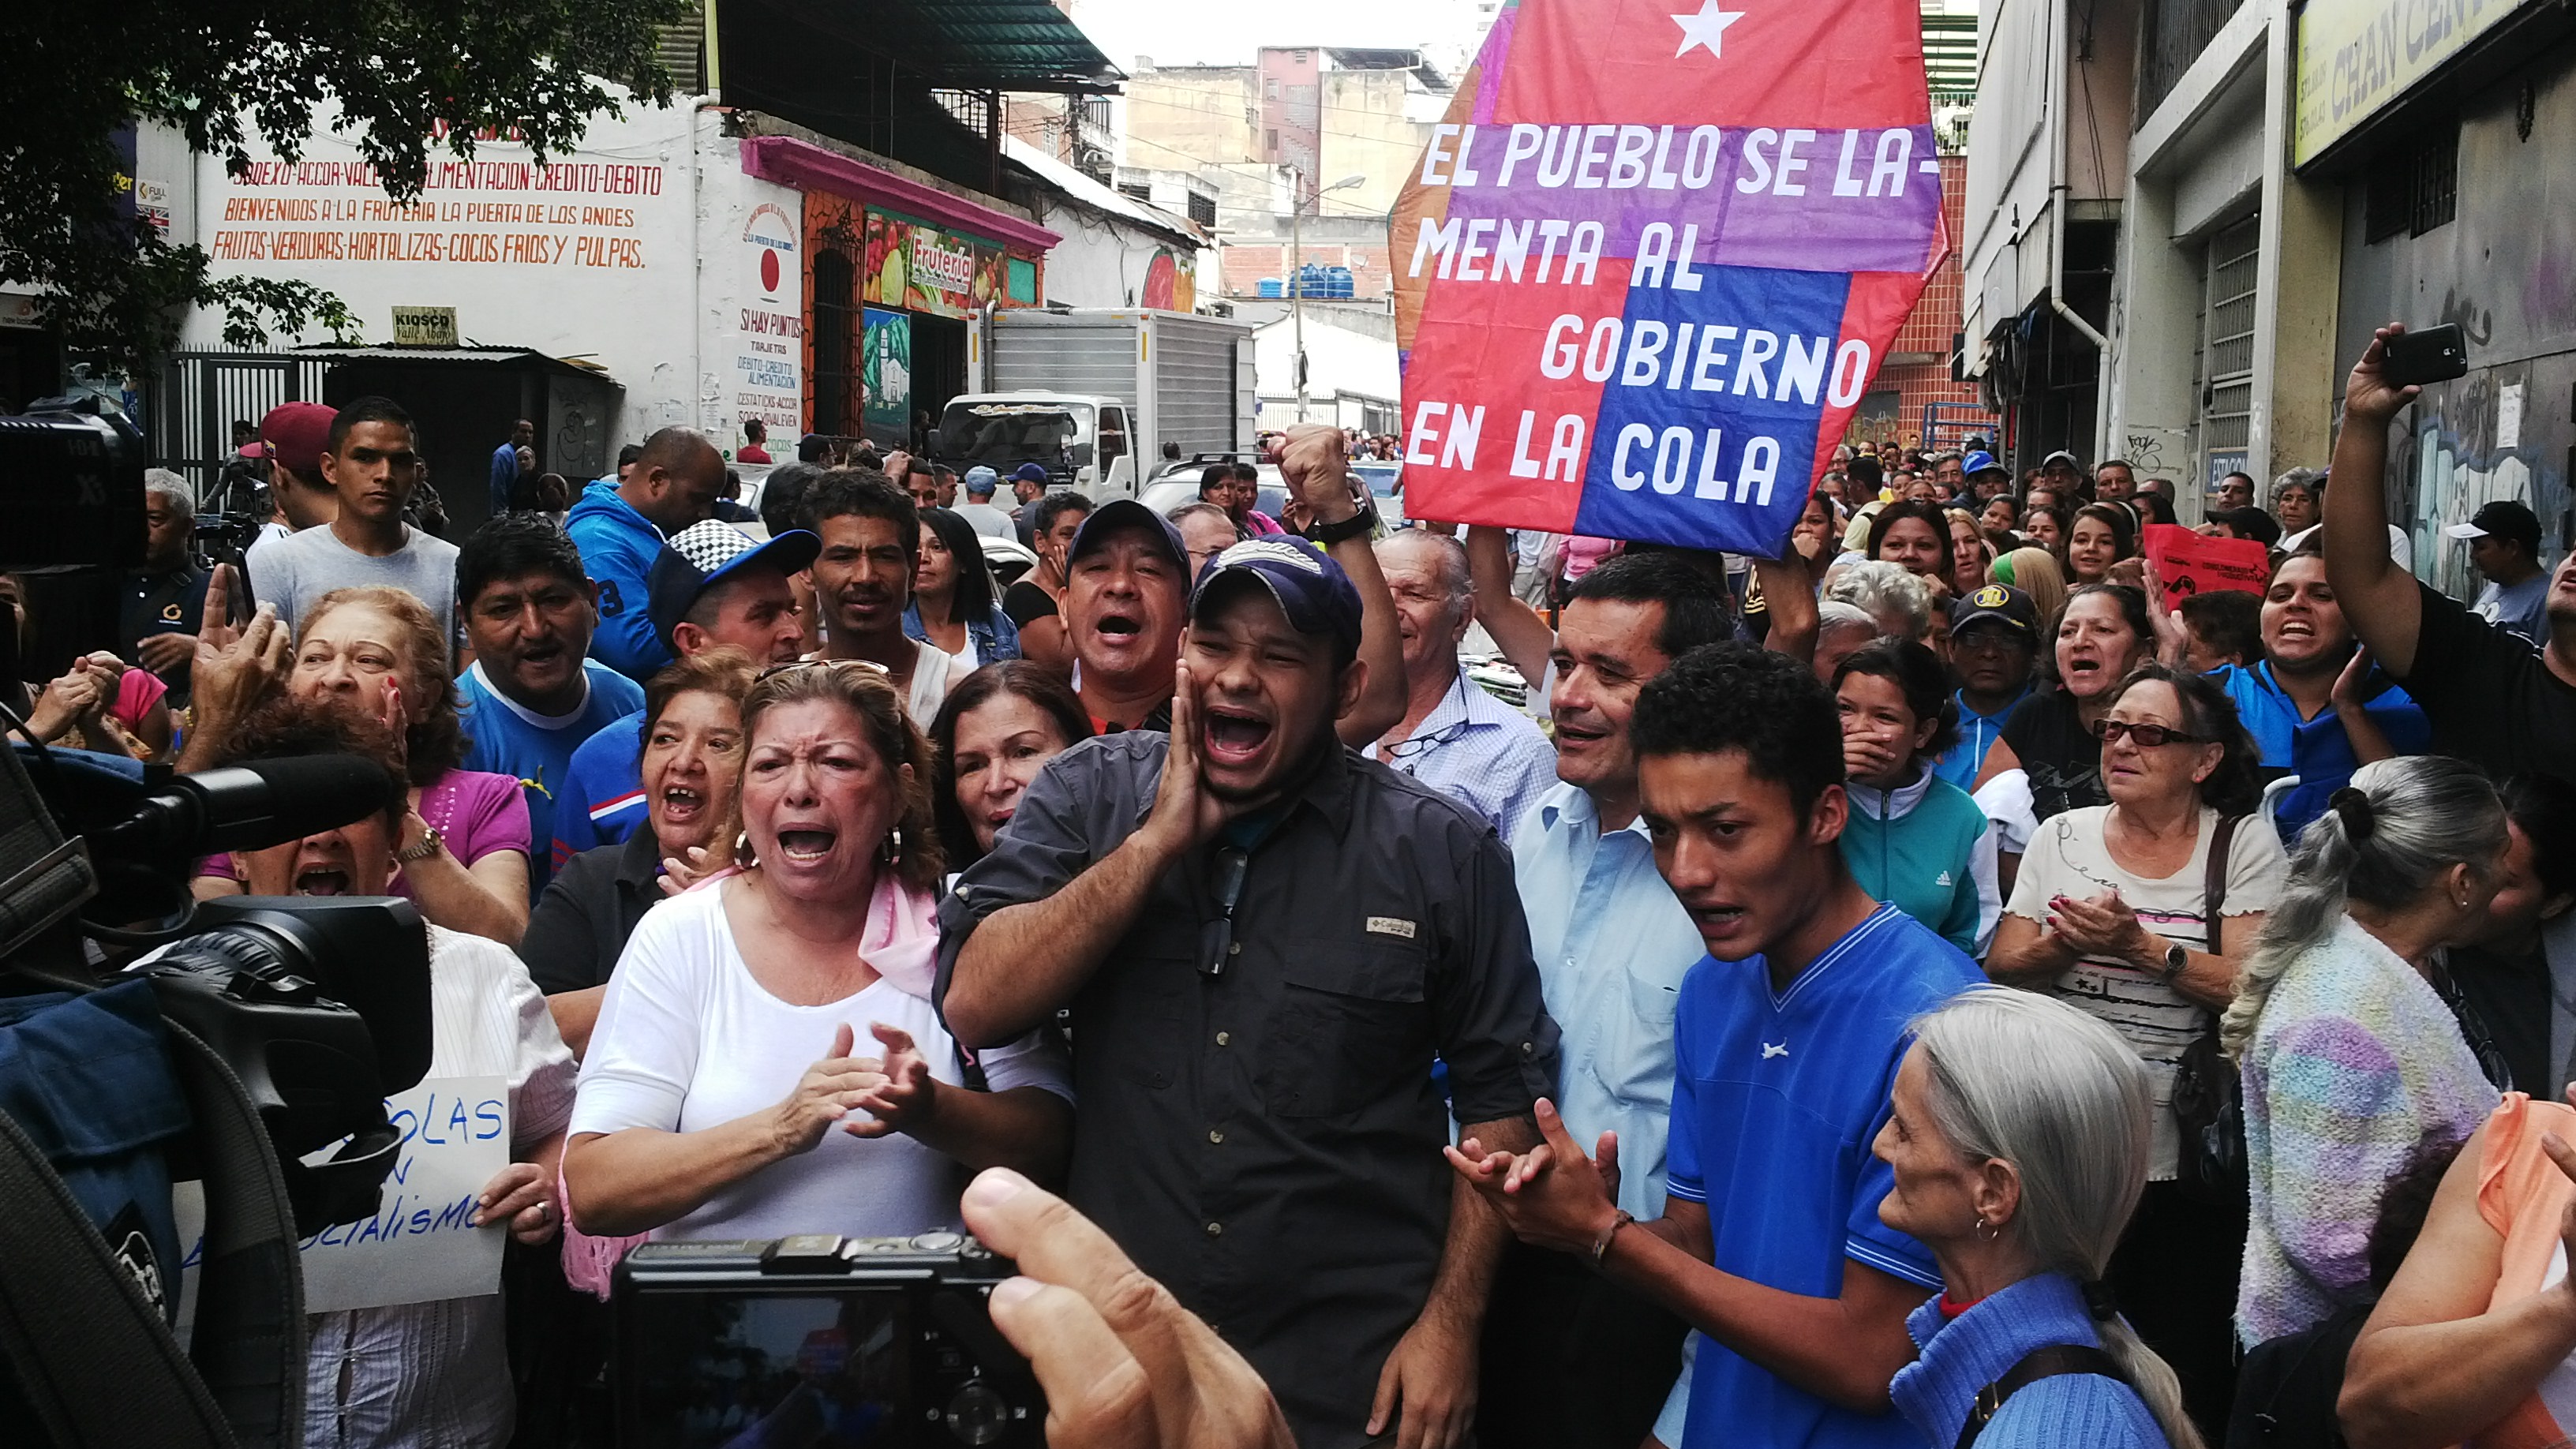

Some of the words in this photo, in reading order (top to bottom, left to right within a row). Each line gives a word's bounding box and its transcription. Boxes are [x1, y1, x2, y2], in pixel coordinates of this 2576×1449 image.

[2332, 0, 2401, 124] CHAN
[1421, 123, 1479, 187] EL
[1497, 124, 1720, 190] PUEBLO
[1736, 127, 1817, 197] SE
[1832, 129, 1940, 197] LA-
[224, 197, 318, 222] BIENVENIDOS
[322, 199, 331, 222] A
[336, 199, 356, 222] LA
[362, 199, 436, 223] FRUTERIA
[442, 202, 461, 223] LA
[466, 202, 522, 223] PUERTA
[526, 204, 545, 224] DE
[549, 204, 577, 225] LOS
[582, 206, 635, 228] ANDES
[503, 234, 550, 264] FRIOS
[552, 234, 568, 265] Y
[575, 236, 646, 269] PULPAS.
[1408, 218, 1604, 285] MENTA
[1631, 222, 1704, 292] AL
[395, 314, 450, 327] KIOSCO
[751, 309, 769, 334] HAY
[769, 313, 801, 339] PUNTOS
[751, 340, 787, 354] TARJETAS
[1540, 314, 1870, 408] GOBIERNO
[1405, 401, 1485, 471] EN
[1509, 410, 1586, 482] LA
[1612, 423, 1781, 507] COLA
